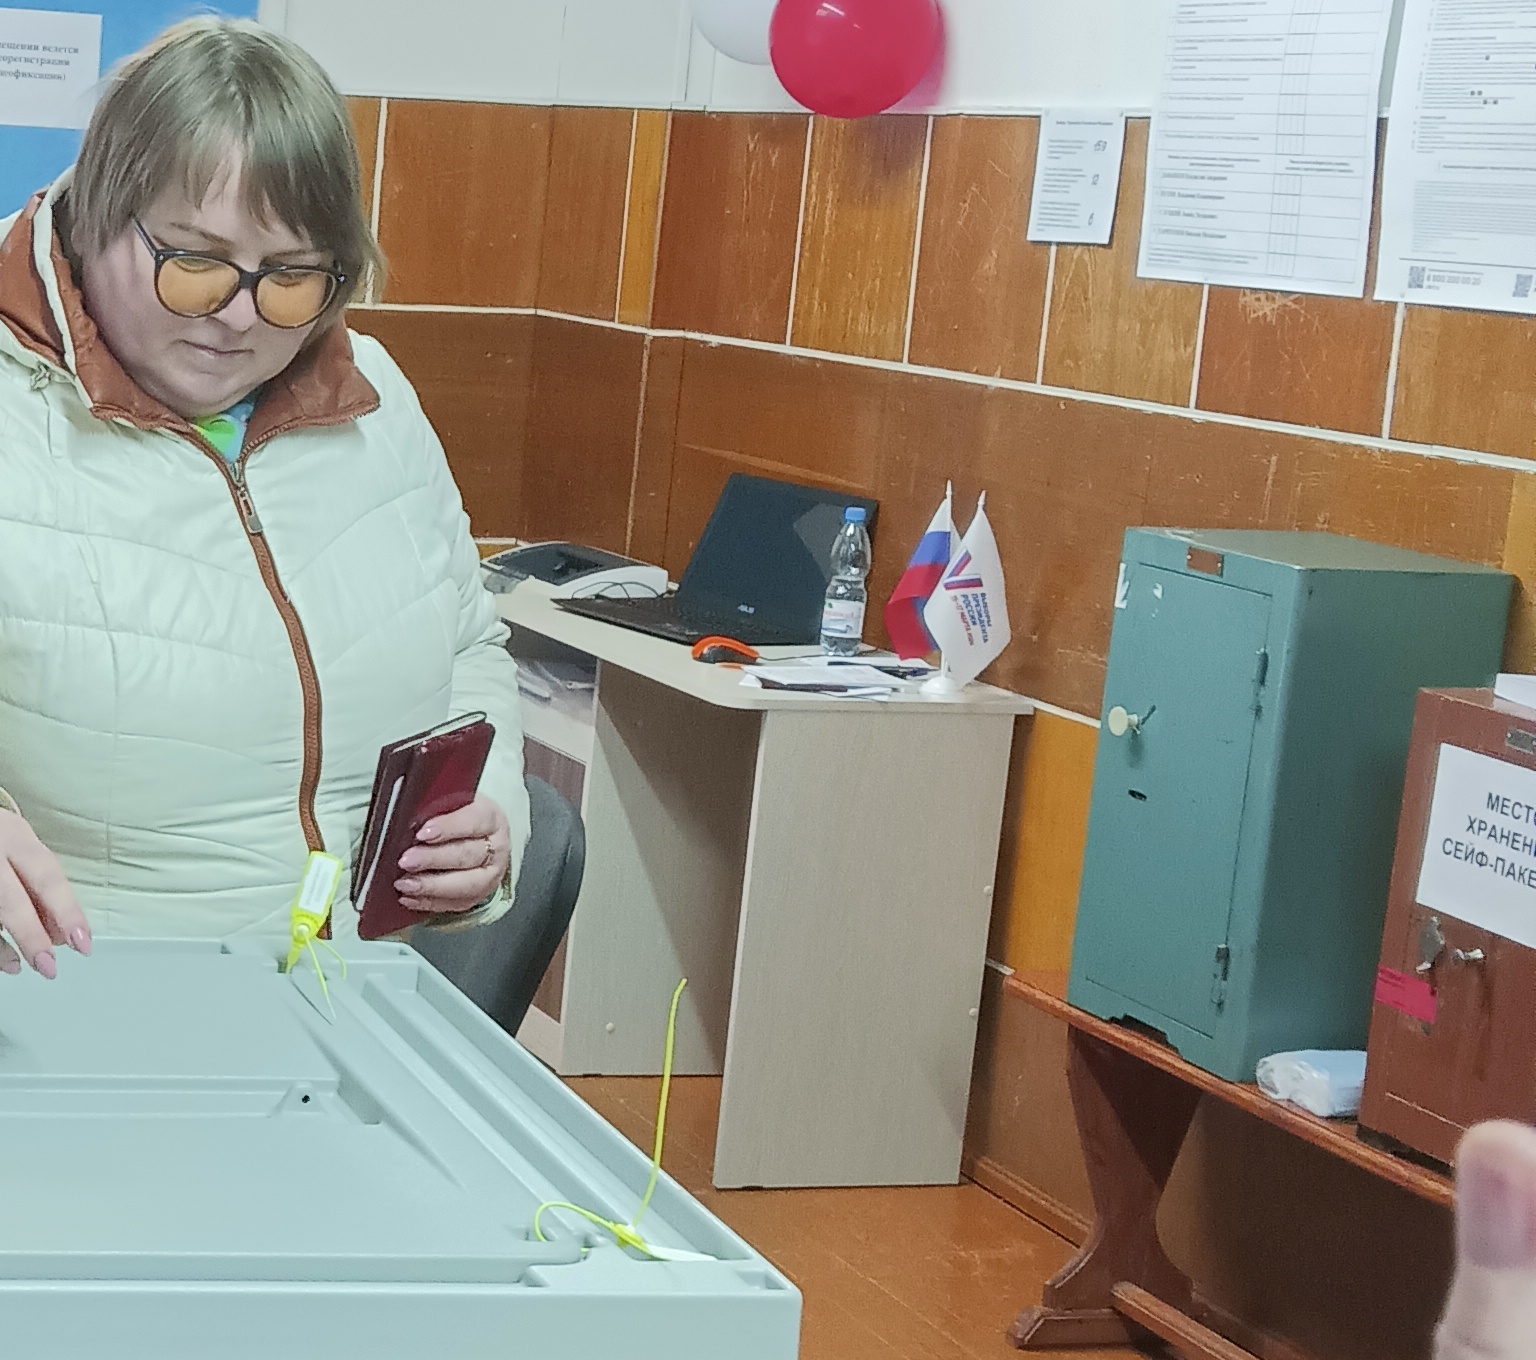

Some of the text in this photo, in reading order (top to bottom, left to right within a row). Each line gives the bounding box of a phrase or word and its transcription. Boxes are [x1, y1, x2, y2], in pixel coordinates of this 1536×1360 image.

[960, 593, 978, 626] РОССИИ
[970, 593, 989, 644] ПРЕЗИДЕНТА
[980, 592, 992, 627] ВЫБОРЫ
[1486, 792, 1536, 826] МЕСТ
[1465, 815, 1536, 858] ХРАНЕН
